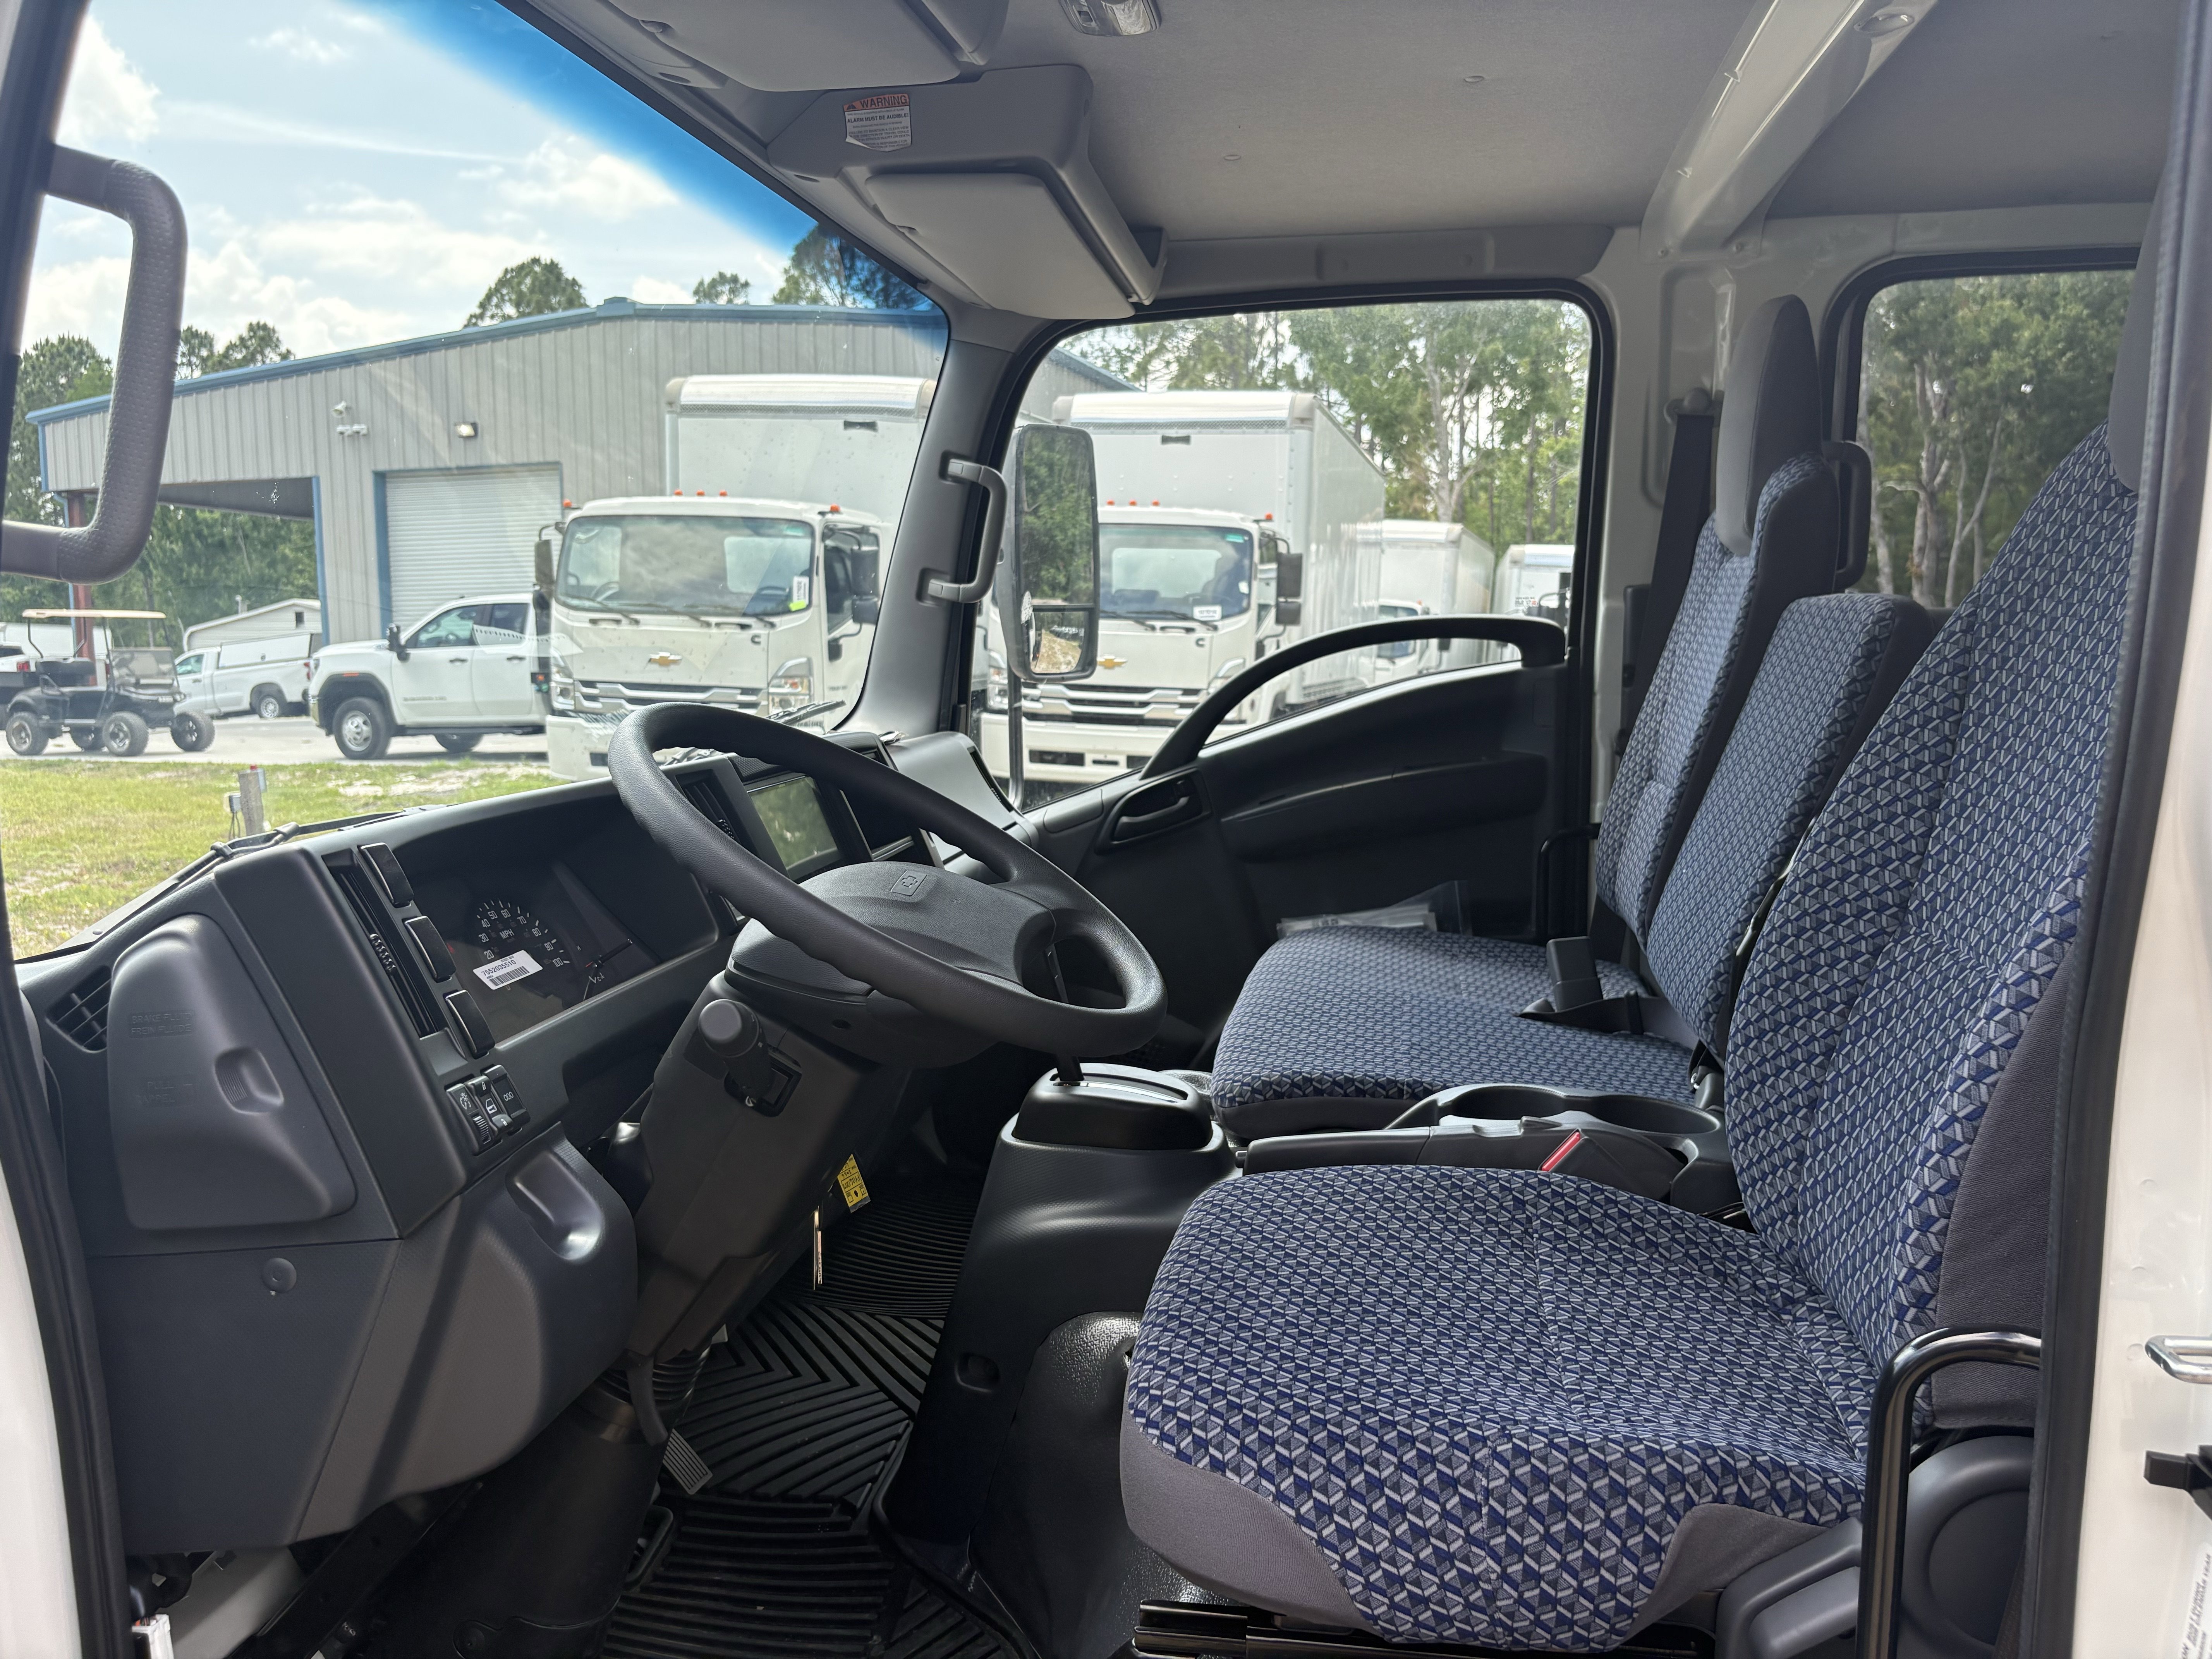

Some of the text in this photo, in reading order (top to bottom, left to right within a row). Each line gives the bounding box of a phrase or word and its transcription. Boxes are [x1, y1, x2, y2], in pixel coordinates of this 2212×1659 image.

[860, 95, 908, 108] WARNING
[488, 910, 498, 920] 50
[501, 909, 511, 918] 60
[481, 919, 491, 928] 40
[517, 916, 527, 925] 70
[500, 928, 515, 939] MPH
[532, 927, 542, 937] 80
[479, 933, 489, 943] 30
[544, 942, 554, 951] 90
[484, 950, 495, 960] 20
[552, 957, 563, 967] 100
[481, 960, 516, 976] 7552035510
[132, 1013, 161, 1024] BRAKE
[131, 1026, 156, 1035] FREIN
[503, 1091, 514, 1101] ODO
